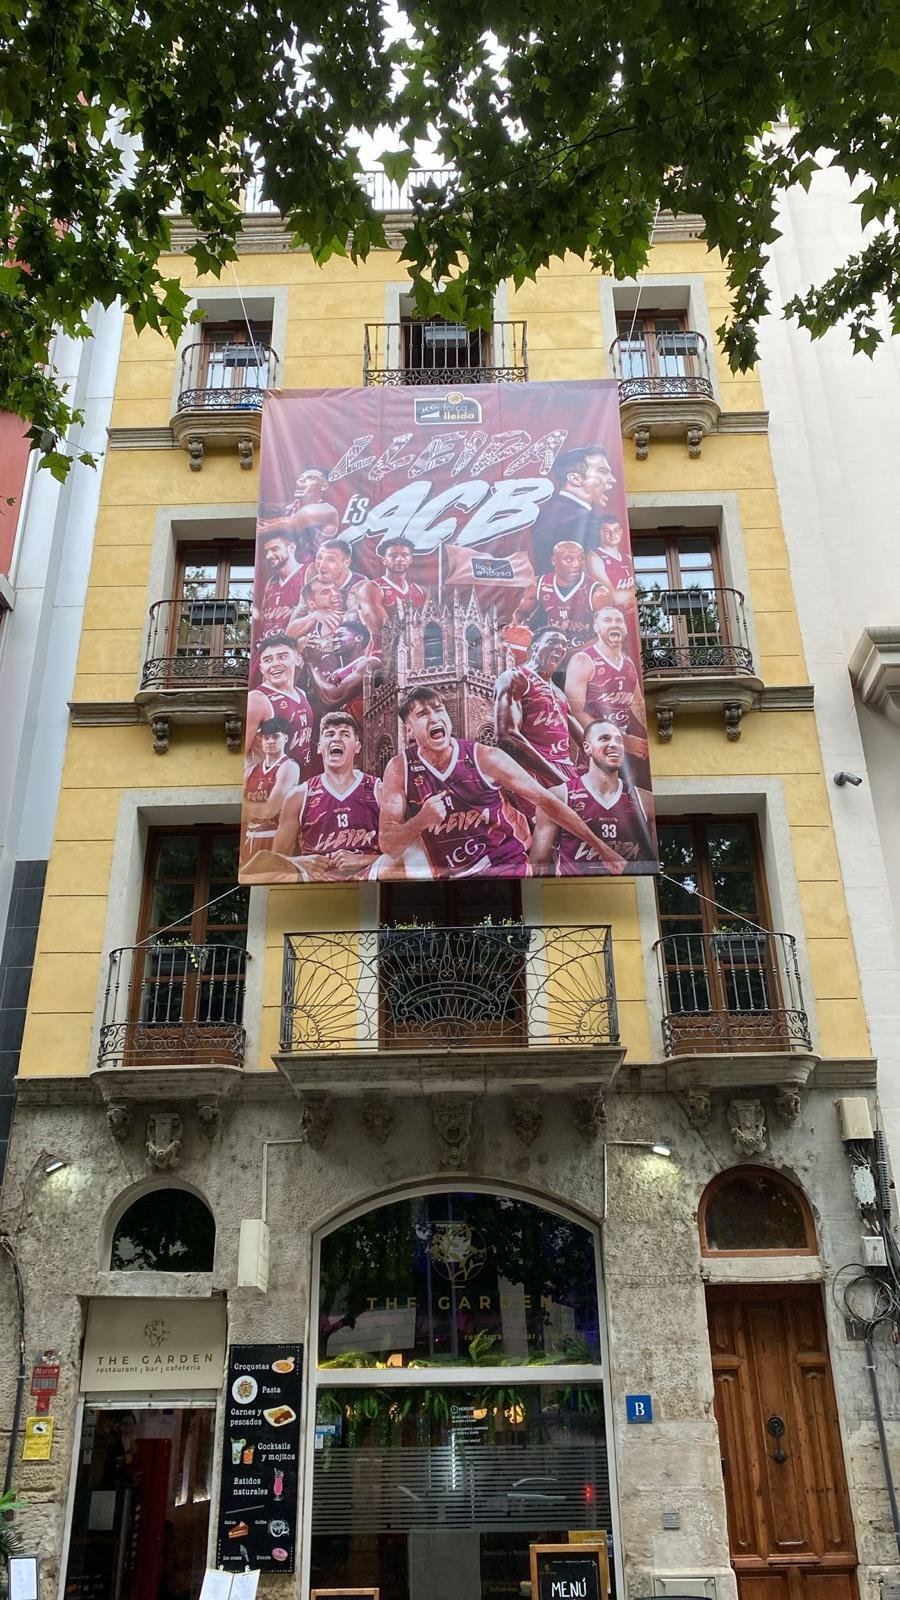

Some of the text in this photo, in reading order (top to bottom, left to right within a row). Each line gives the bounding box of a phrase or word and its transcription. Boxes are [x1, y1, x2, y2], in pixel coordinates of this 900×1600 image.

[443, 411, 475, 420] lleida
[328, 429, 568, 482] LLEIDA
[334, 478, 555, 553] ÉS ACB
[336, 813, 349, 828] 13
[601, 823, 617, 838] 33
[314, 828, 377, 851] LLEIDA
[445, 838, 487, 868] ICG
[366, 1296, 417, 1310] THE
[97, 1353, 213, 1366] THE GARDEN
[96, 1366, 138, 1374] restaurant
[165, 1364, 201, 1372] cafeteria
[233, 1363, 270, 1372] Croquetas
[261, 1386, 281, 1394] Pasta
[230, 1408, 263, 1417] Carnes y
[634, 1401, 645, 1416] B
[229, 1418, 262, 1427] pescados
[257, 1442, 291, 1450] Cocktails
[261, 1453, 296, 1462] y mojitos
[233, 1477, 261, 1485] Batidos
[232, 1488, 268, 1496] naturales
[551, 1576, 587, 1598] MENÚ
